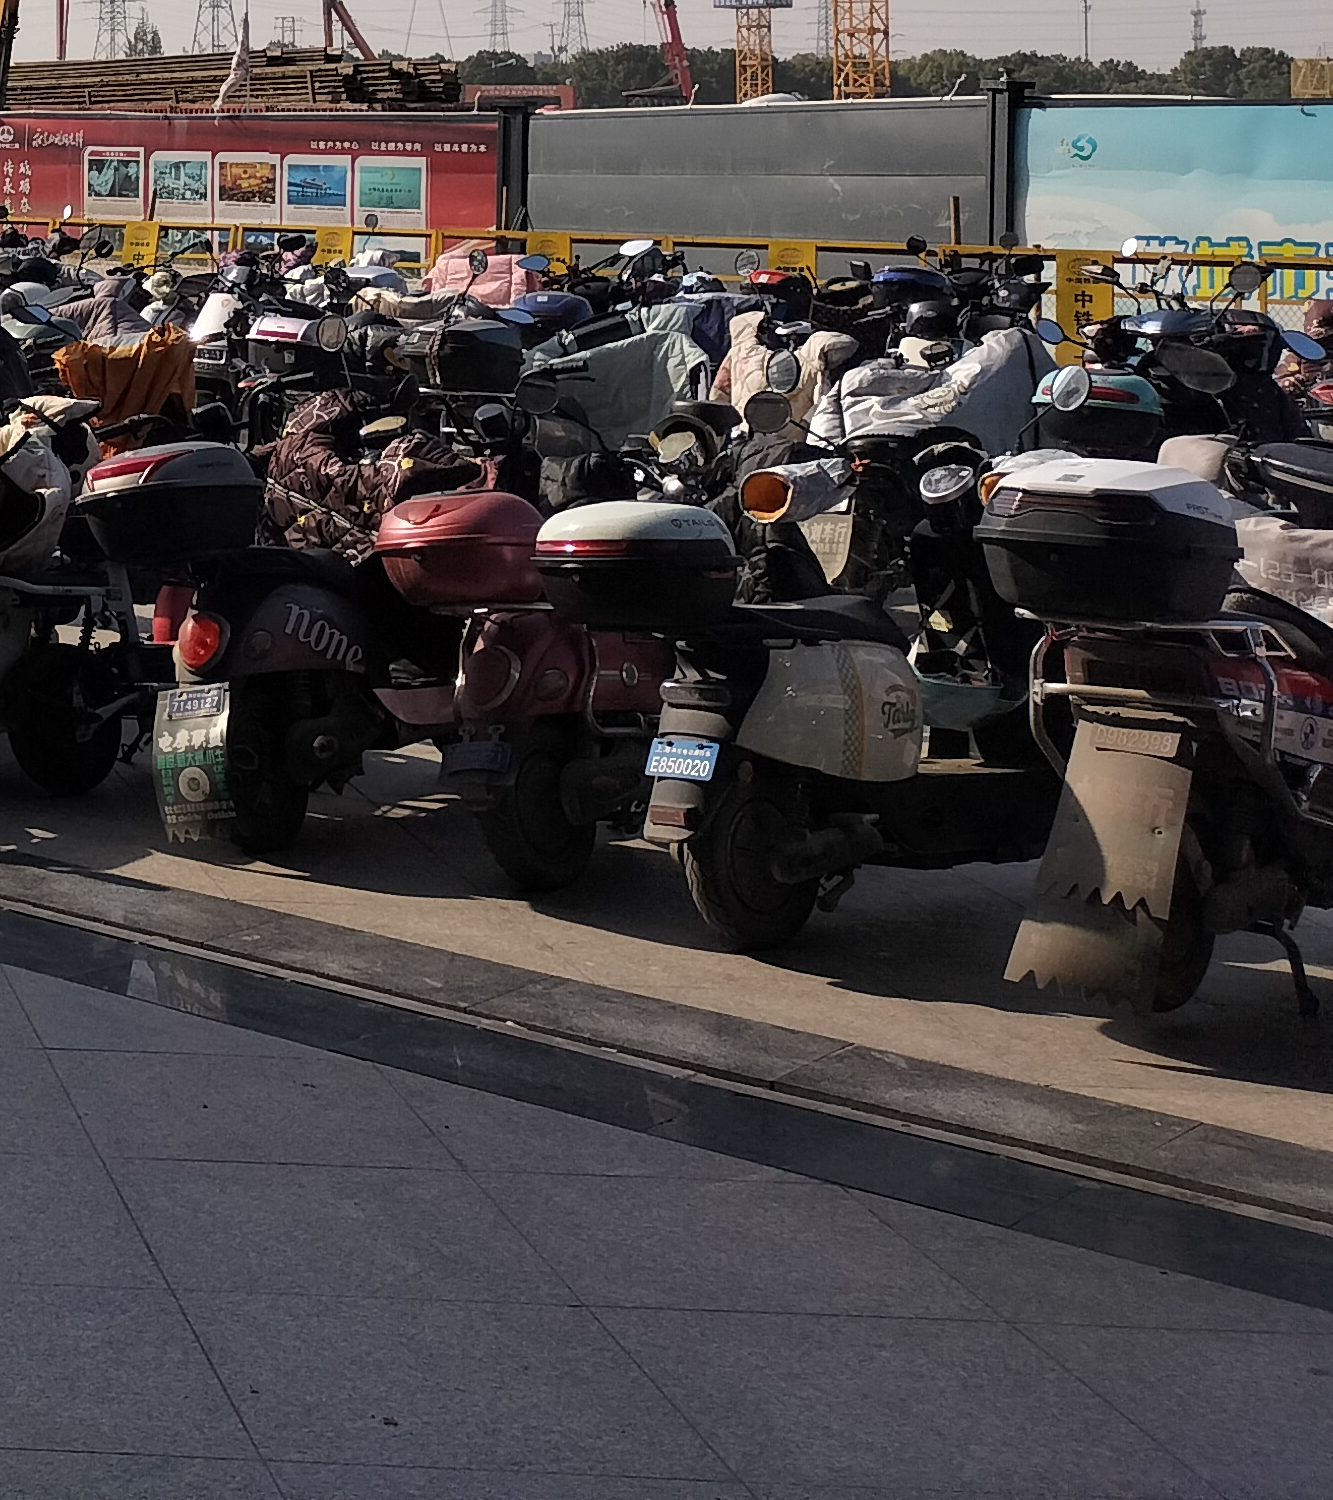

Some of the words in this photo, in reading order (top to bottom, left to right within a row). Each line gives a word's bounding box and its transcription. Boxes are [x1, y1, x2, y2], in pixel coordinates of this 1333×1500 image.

[284, 603, 365, 674] none
[172, 697, 218, 712] 7149127
[650, 756, 709, 777] E850020
